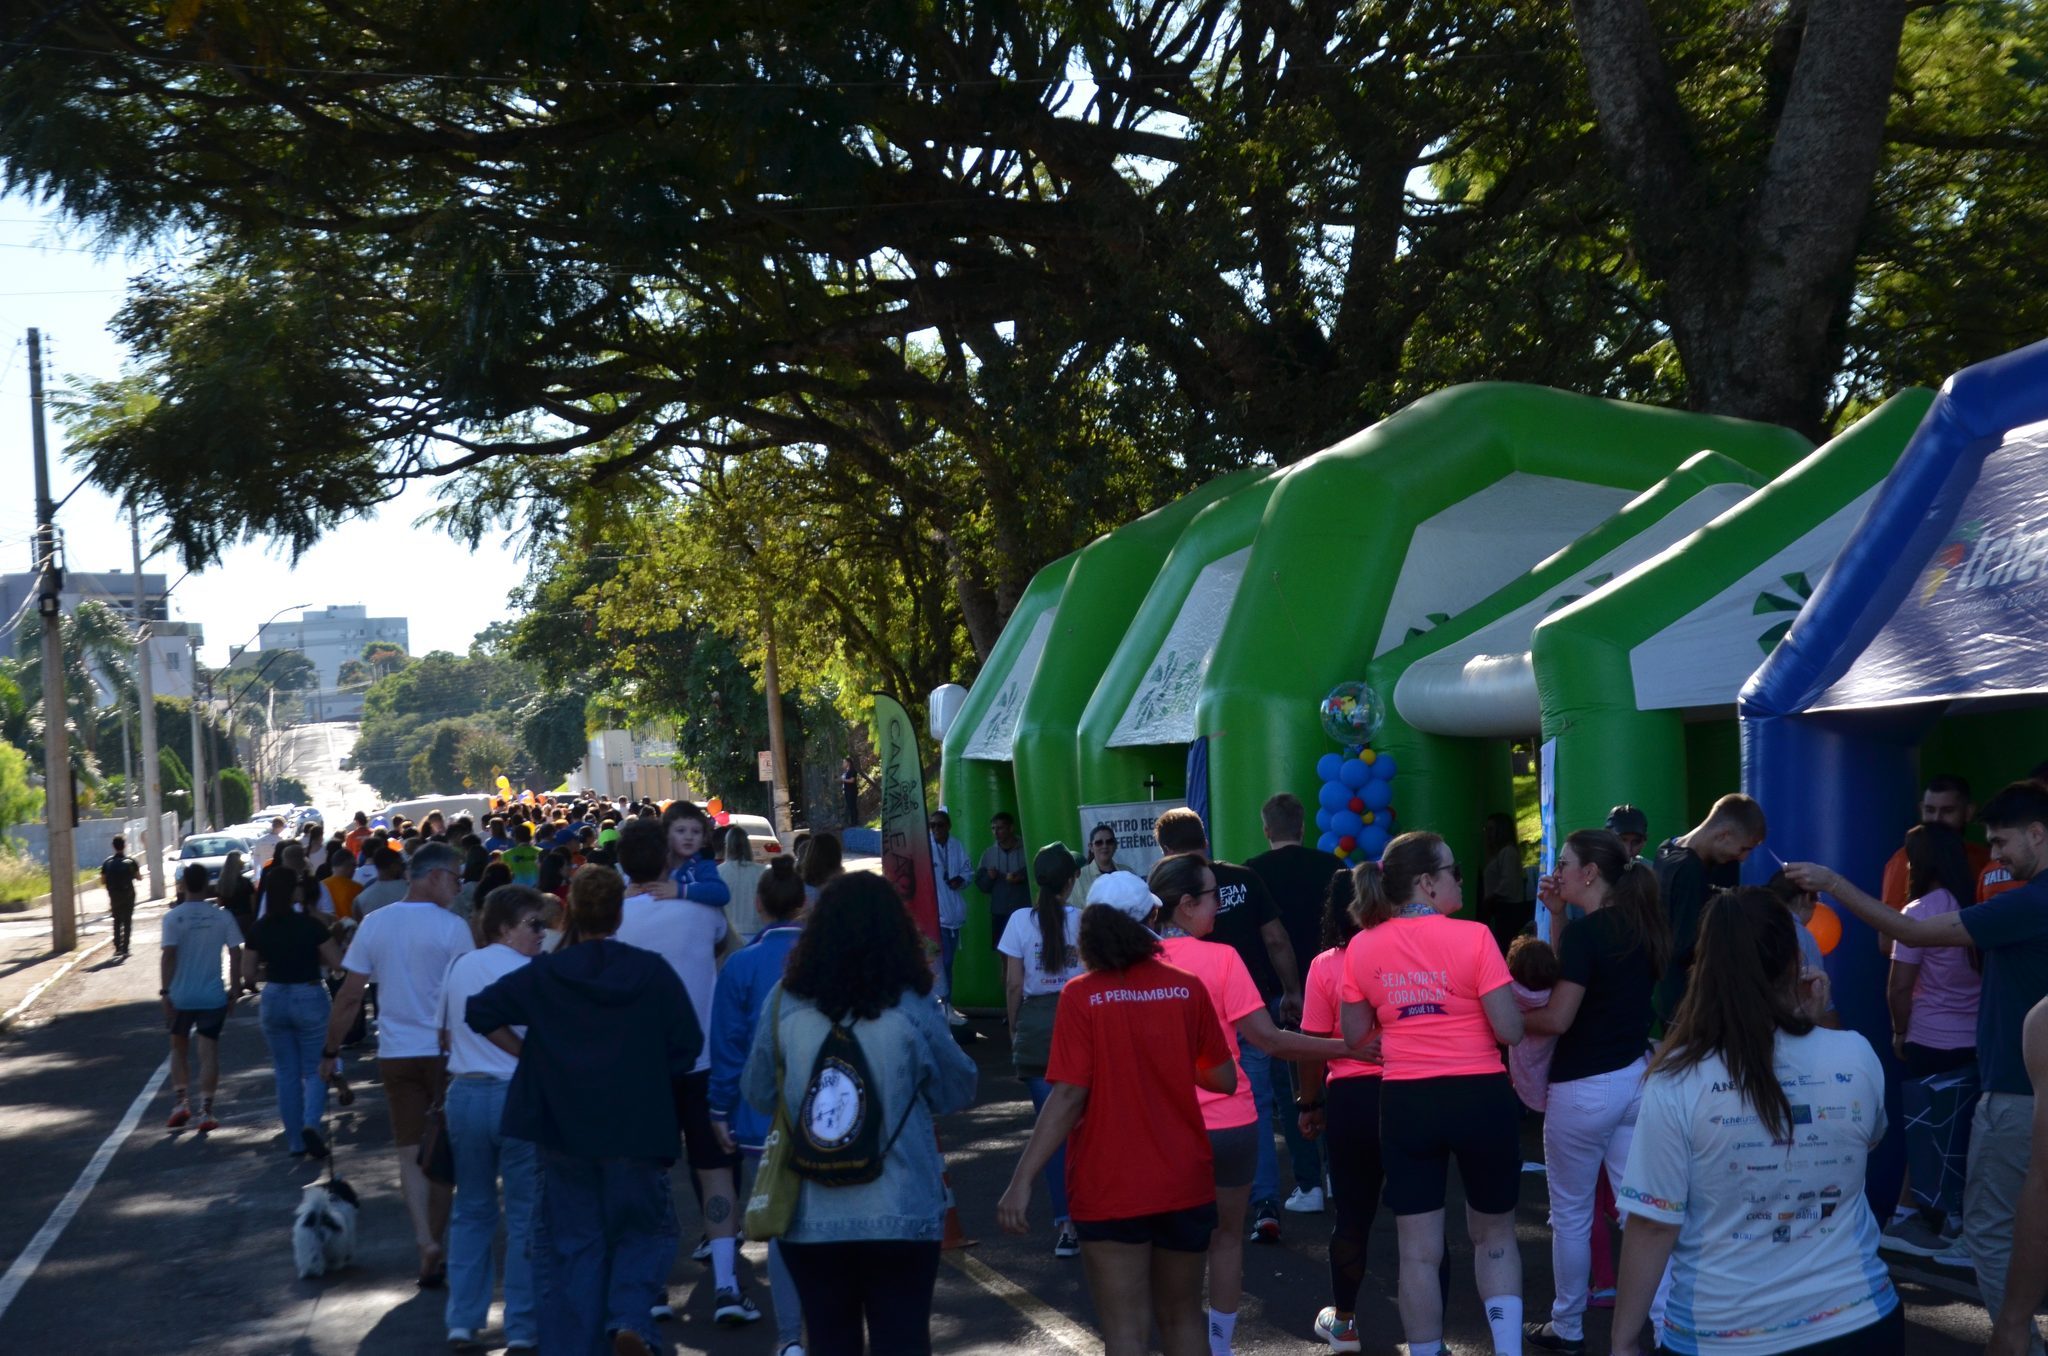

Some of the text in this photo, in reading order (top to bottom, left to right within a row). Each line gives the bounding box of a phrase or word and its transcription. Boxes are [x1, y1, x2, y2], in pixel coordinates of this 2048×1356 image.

[1381, 973, 1406, 988] SEJA
[1408, 971, 1438, 986] FORTE
[1105, 986, 1190, 1003] PERNAMBUCO
